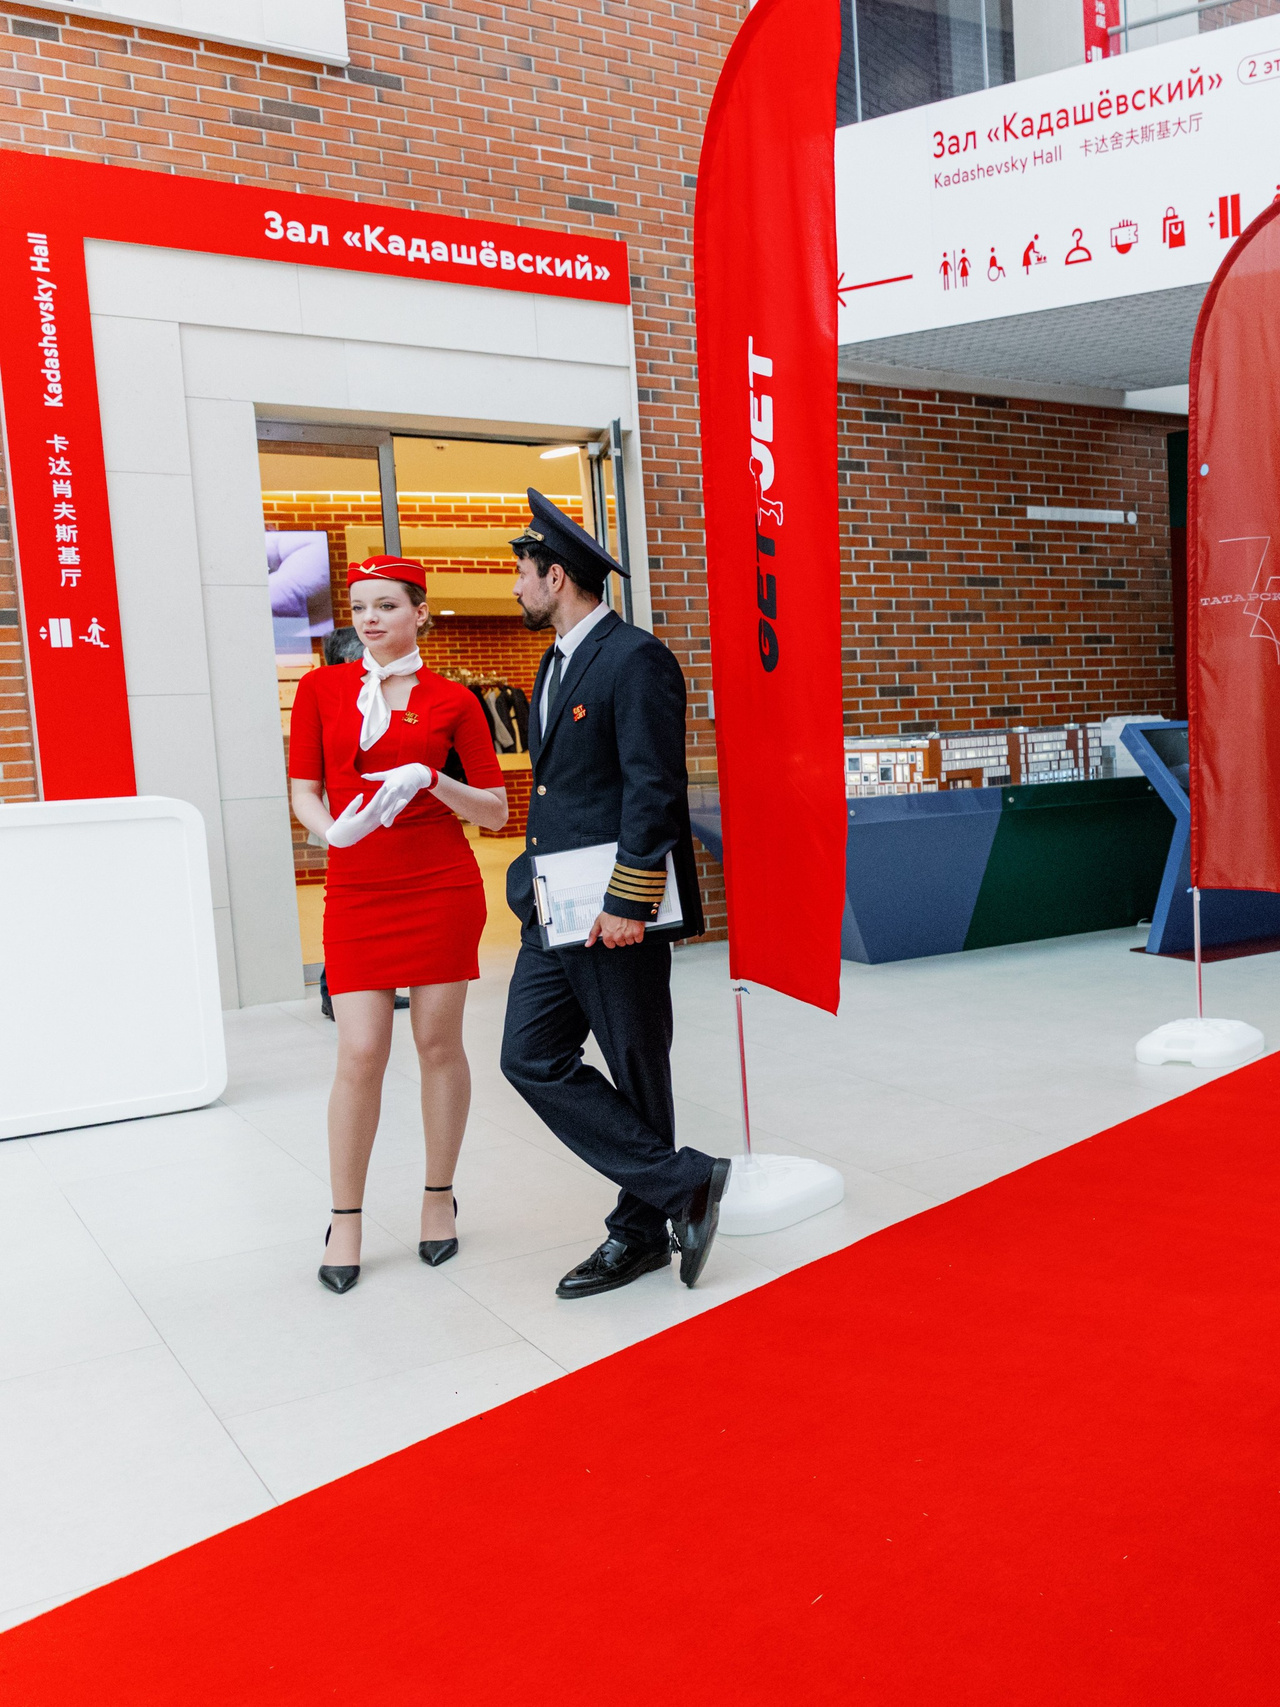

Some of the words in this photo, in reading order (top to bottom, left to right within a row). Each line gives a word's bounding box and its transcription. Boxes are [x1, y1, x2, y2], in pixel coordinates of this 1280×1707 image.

[1247, 60, 1258, 78] 2
[932, 129, 978, 159] Зал
[987, 66, 1223, 143] «Кадашёвский»
[1079, 112, 1203, 157] 卡达舍夫斯基大厅
[933, 155, 1029, 189] Kadashevsky
[1032, 145, 1063, 167] Hall
[27, 232, 51, 272] Hall
[263, 210, 329, 247] Зал
[342, 224, 611, 281] «Кадашёвский»
[33, 277, 64, 407] Kadashevsky
[748, 336, 775, 491] JET
[46, 434, 82, 587] 卡达肖夫斯基厅
[755, 513, 779, 673] GET
